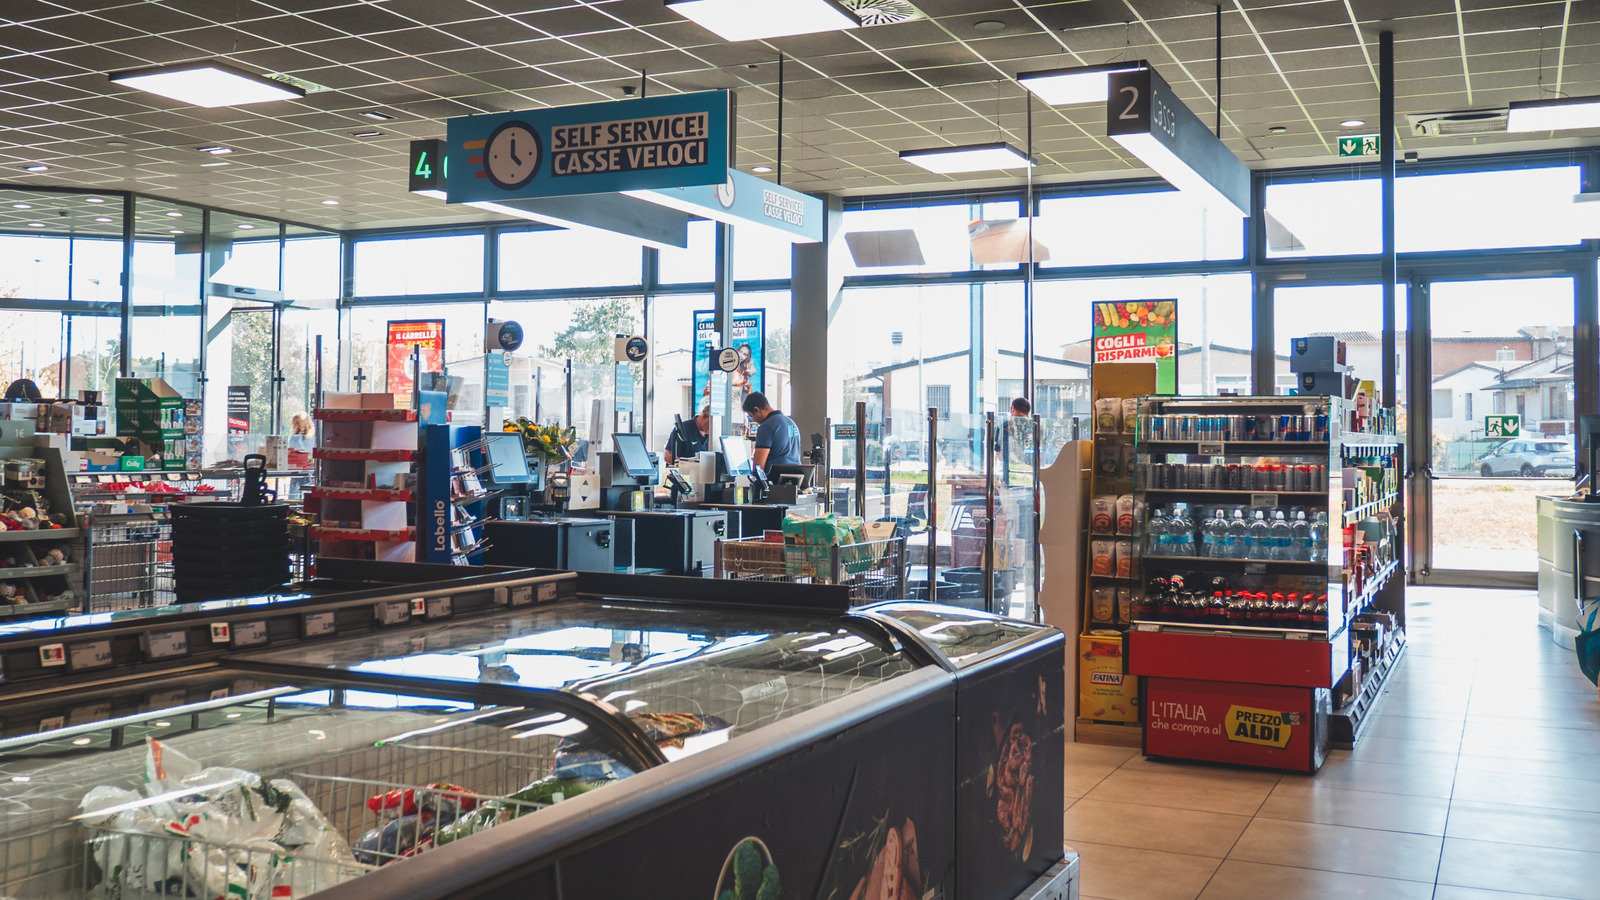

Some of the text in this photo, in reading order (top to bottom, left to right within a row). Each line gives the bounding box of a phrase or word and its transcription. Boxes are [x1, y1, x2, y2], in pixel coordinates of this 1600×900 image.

[1118, 86, 1139, 120] 2
[1152, 90, 1175, 138] Cassa
[555, 115, 704, 149] SELF SERVICE!
[415, 151, 432, 178] 4
[554, 142, 704, 174] CASSE VELOCI
[764, 191, 777, 205] SELF
[764, 204, 803, 226] CASSE VELOCI
[402, 330, 437, 339] CARRELLO
[1097, 336, 1135, 349] COGLI
[434, 500, 445, 551] Labello
[1094, 674, 1120, 682] FATINA
[1152, 701, 1206, 721] L'ITALIA
[1236, 710, 1281, 726] PREZZO
[1152, 718, 1221, 736] che compra al
[1235, 722, 1279, 742] ALDI
